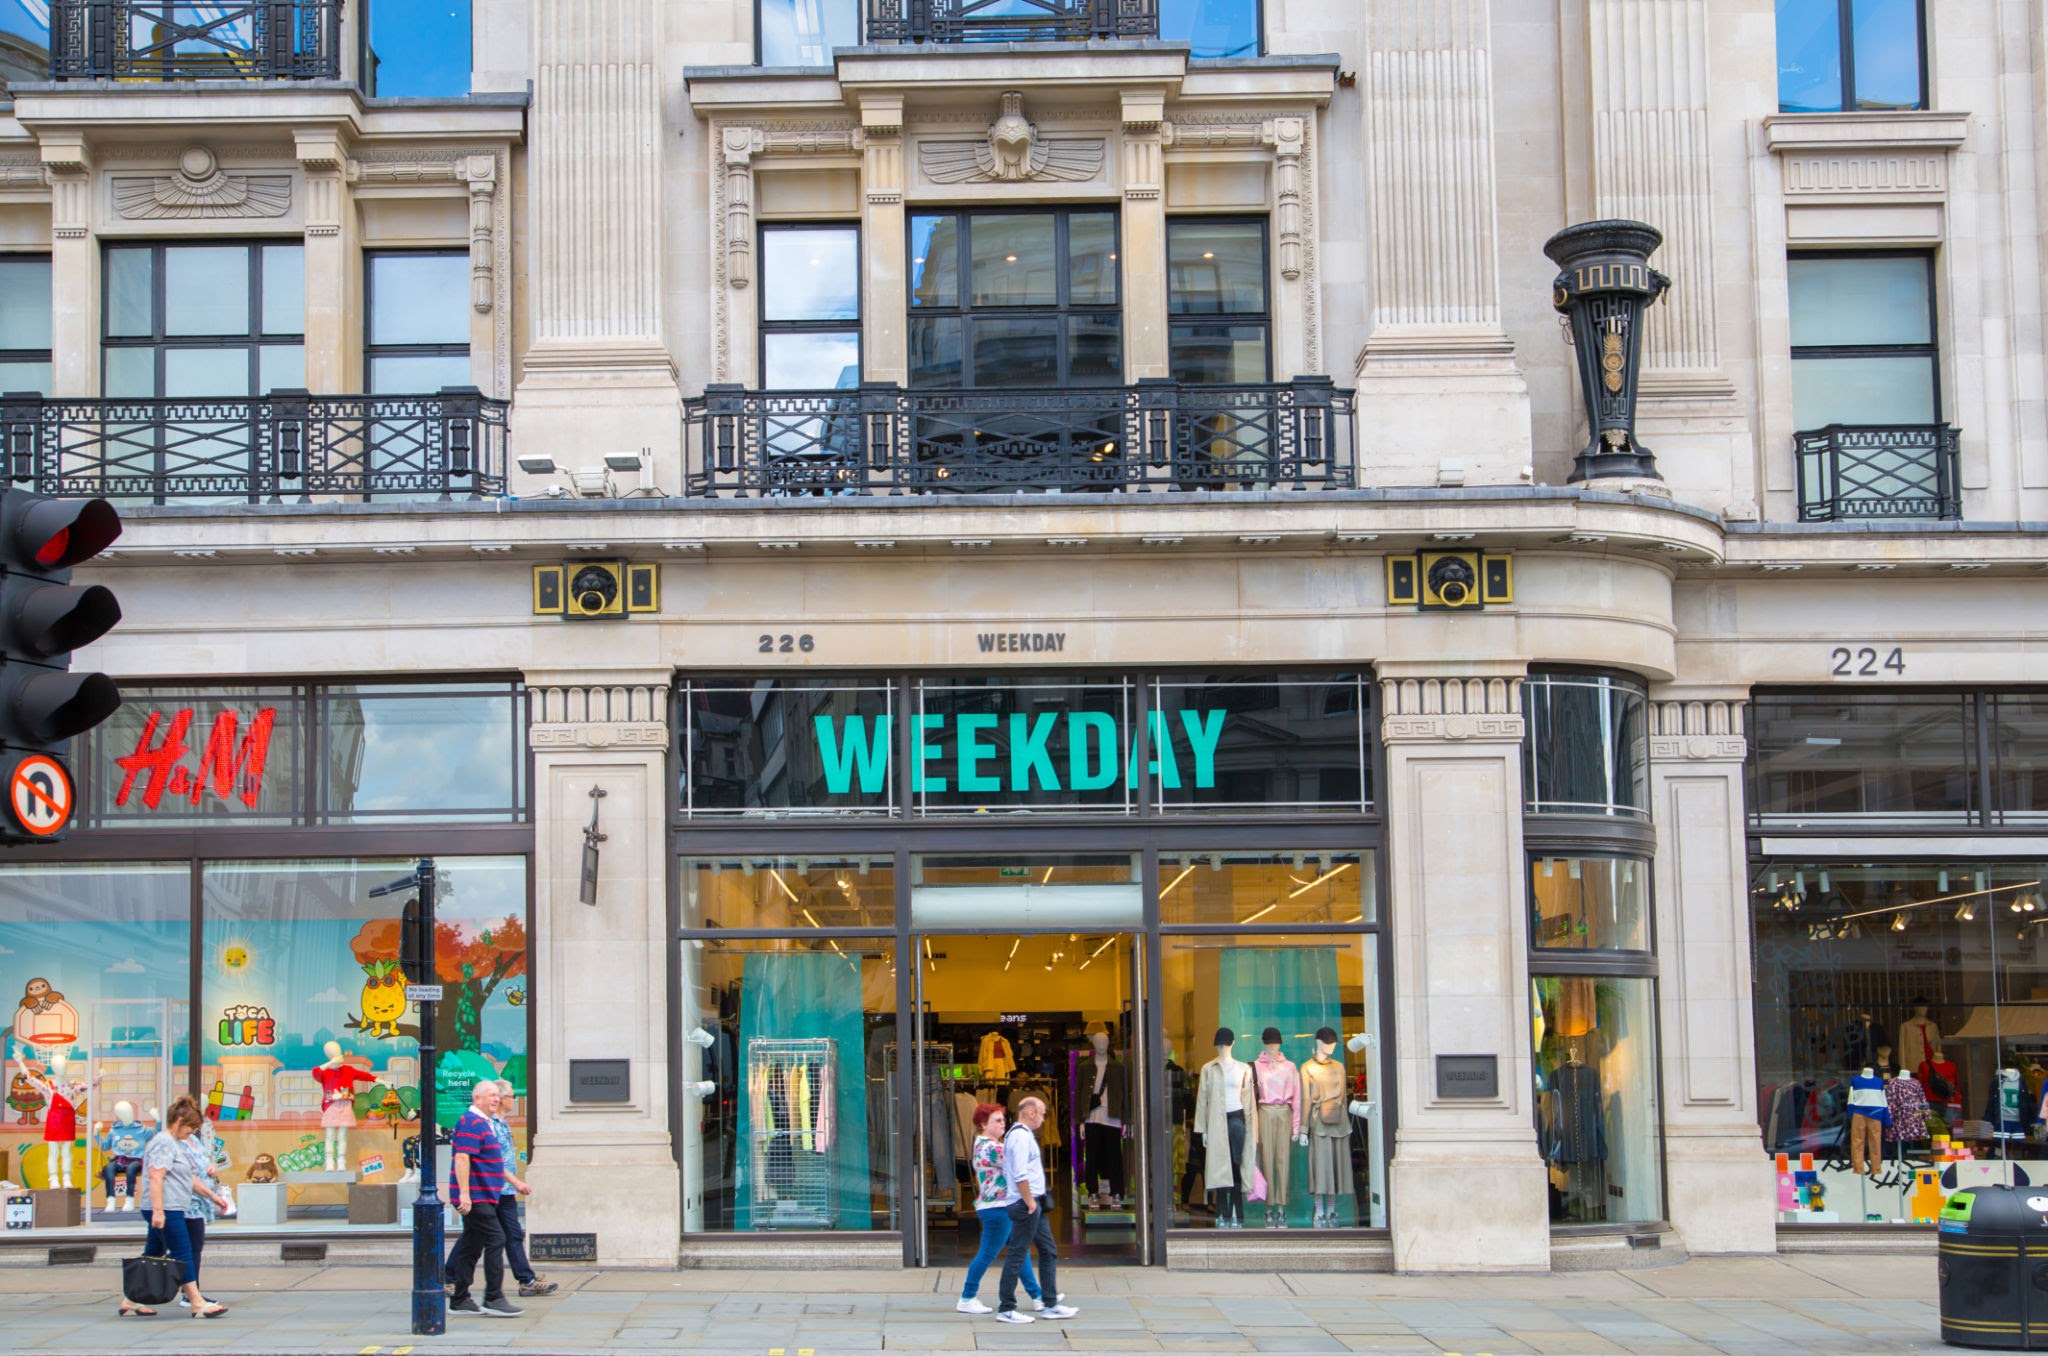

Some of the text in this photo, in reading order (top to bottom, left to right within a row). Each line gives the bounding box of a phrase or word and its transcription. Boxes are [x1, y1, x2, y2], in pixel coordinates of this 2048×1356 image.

[759, 634, 814, 652] 226
[978, 632, 1066, 652] WEEKDAY
[1832, 647, 1906, 676] 224
[114, 706, 276, 810] H&M
[814, 709, 1227, 794] WEEKDAY
[224, 1005, 270, 1020] TOCA
[219, 1019, 275, 1045] LIFE
[442, 1070, 476, 1079] Recycle
[448, 1079, 470, 1087] here!
[561, 1237, 595, 1245] EXTRACT
[531, 1246, 595, 1255] SUB BASEMENT
